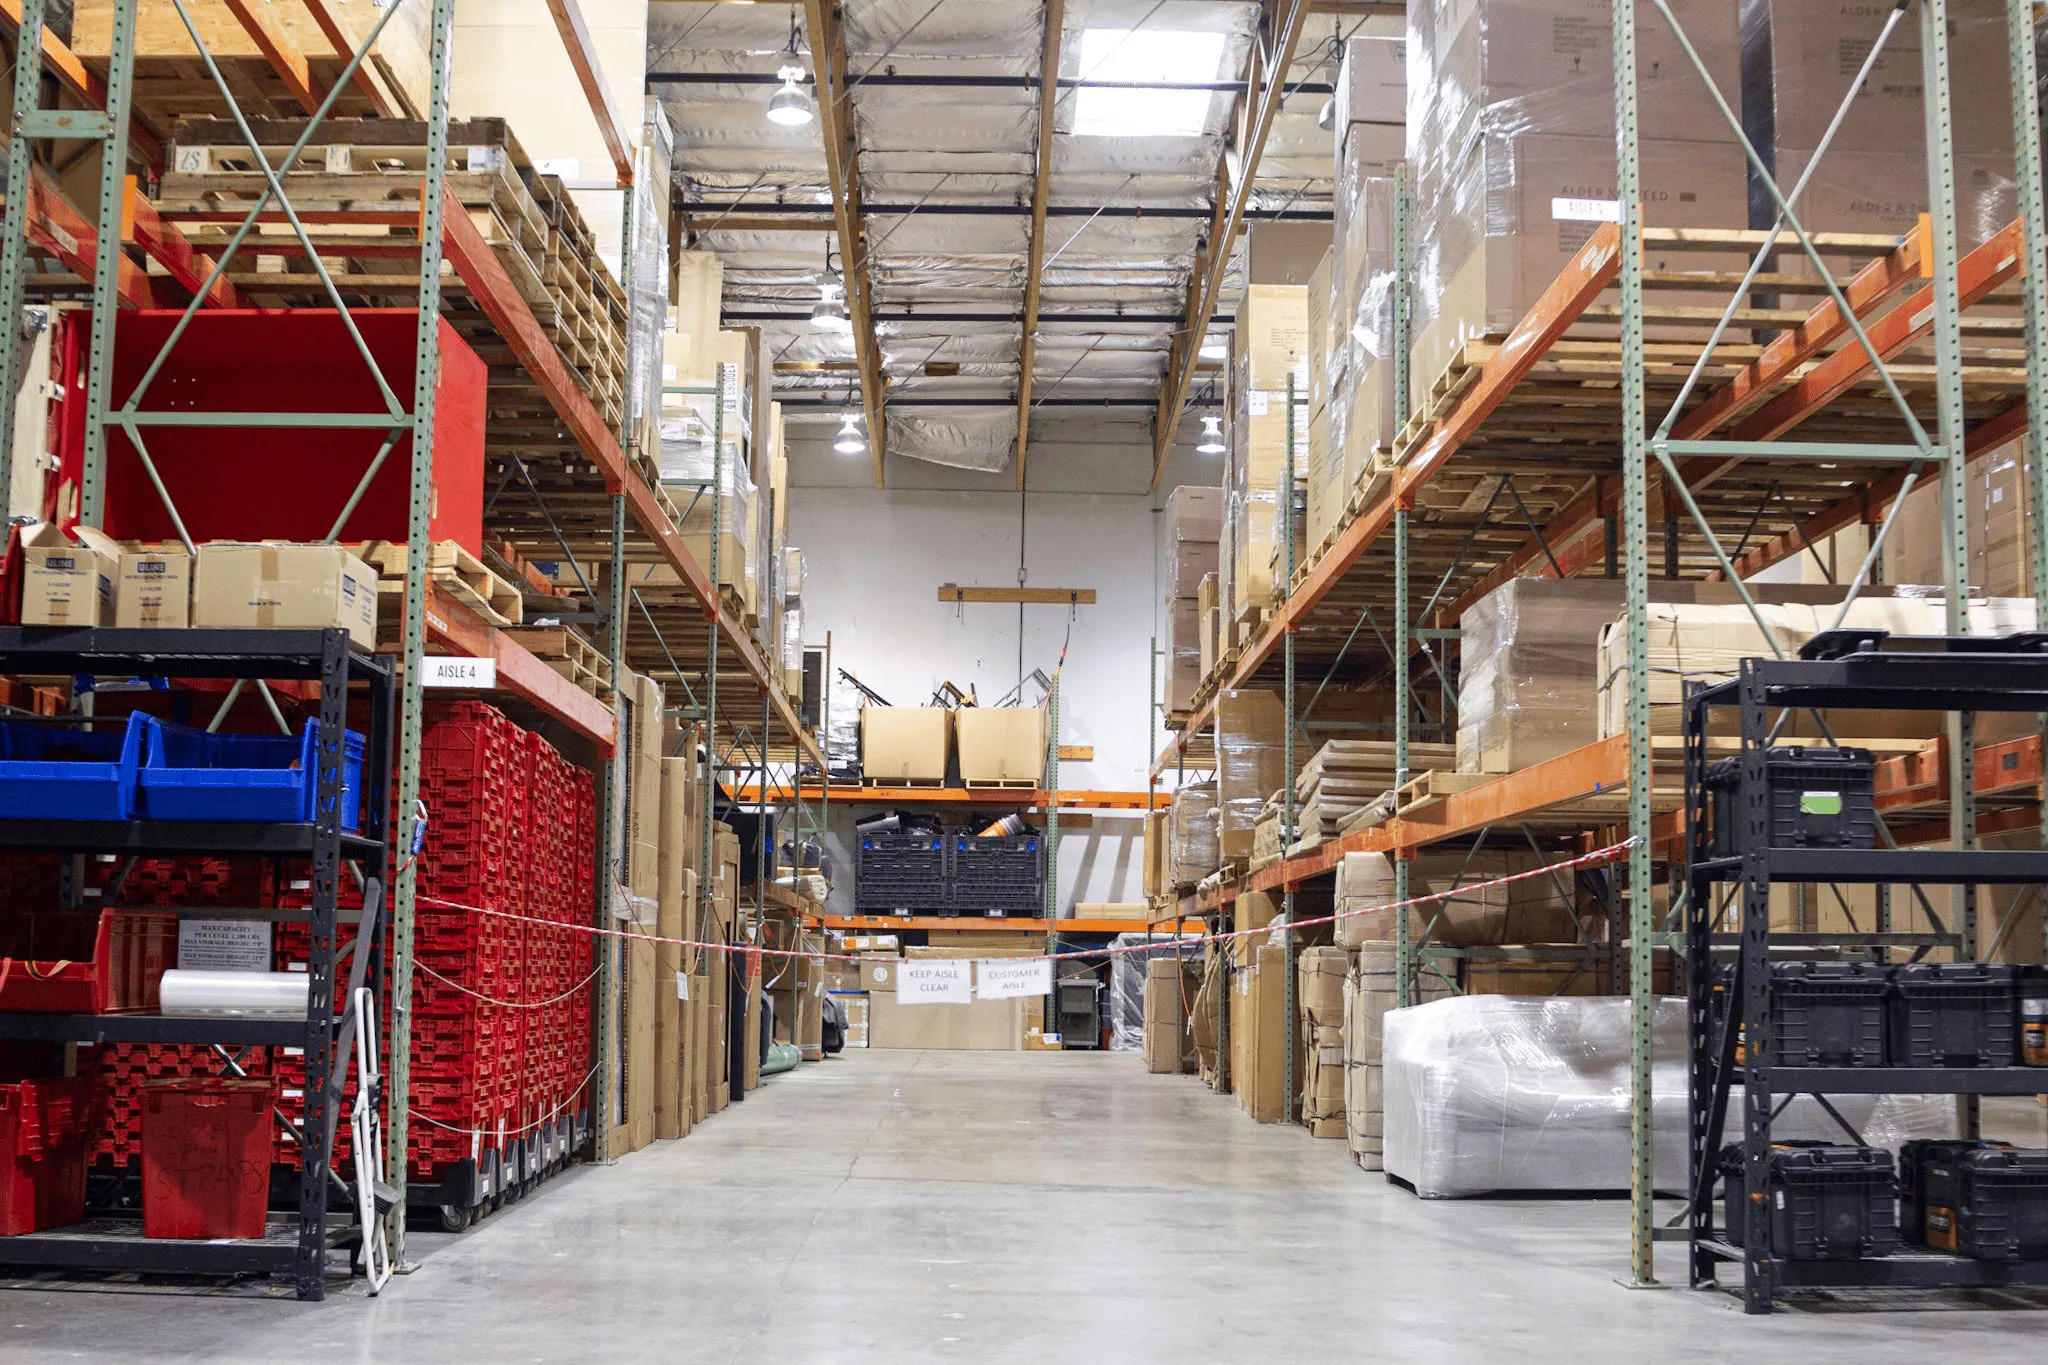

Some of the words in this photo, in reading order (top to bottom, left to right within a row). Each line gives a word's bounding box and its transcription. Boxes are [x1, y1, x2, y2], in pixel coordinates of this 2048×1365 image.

[1559, 185, 1604, 197] ALDER
[47, 558, 75, 569] ULINE
[138, 562, 166, 572] ULINE
[437, 665, 466, 678] AISLE
[469, 666, 476, 679] 4
[909, 969, 932, 978] KEEP
[934, 969, 960, 978] AISLE
[988, 968, 1041, 981] CUSTOMER
[919, 983, 950, 993] CLEAR
[1002, 980, 1027, 990] AISLE
